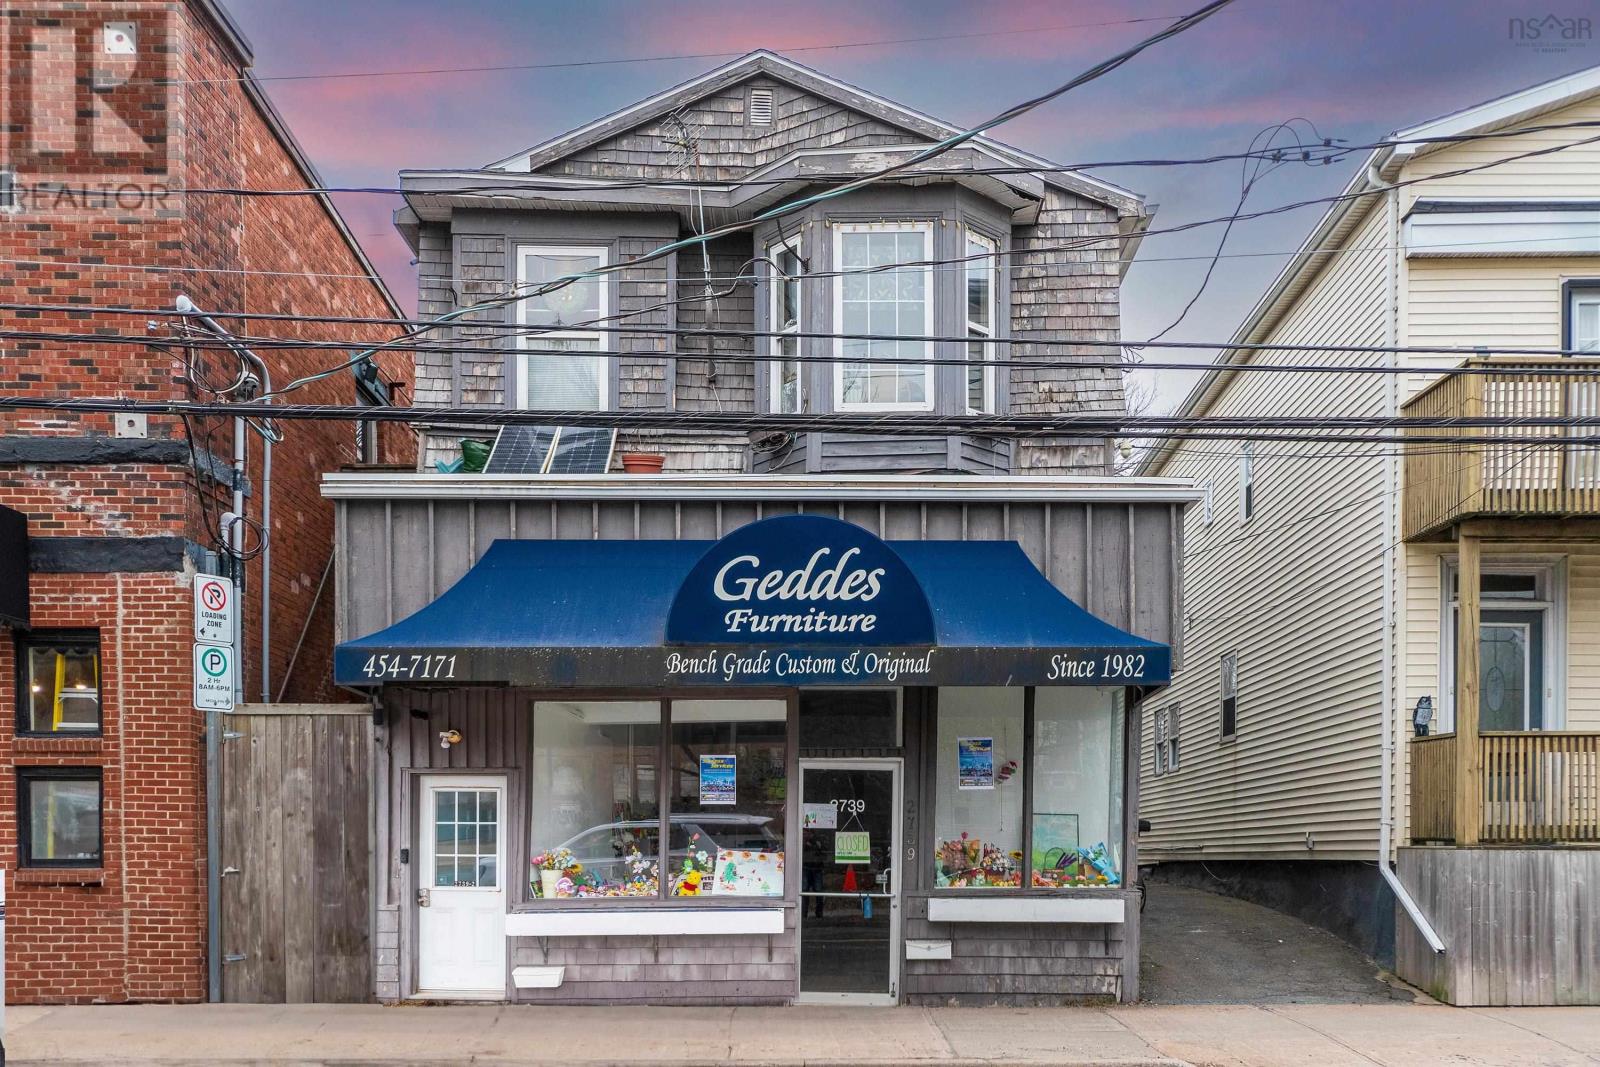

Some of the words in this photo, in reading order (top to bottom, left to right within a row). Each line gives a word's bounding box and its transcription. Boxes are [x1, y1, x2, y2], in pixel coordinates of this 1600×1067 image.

[713, 547, 885, 602] Geddes
[201, 610, 227, 621] LOADING
[206, 619, 222, 629] ZONE
[724, 607, 877, 633] Furniture
[363, 654, 457, 678] 454-7171
[666, 650, 717, 674] Bench
[723, 650, 770, 681] Grade
[776, 652, 836, 676] Custom
[841, 652, 860, 675] &
[864, 649, 934, 681] Original
[1047, 653, 1095, 680] Since
[1101, 654, 1145, 678] 1982
[837, 834, 869, 853] CLOSED
